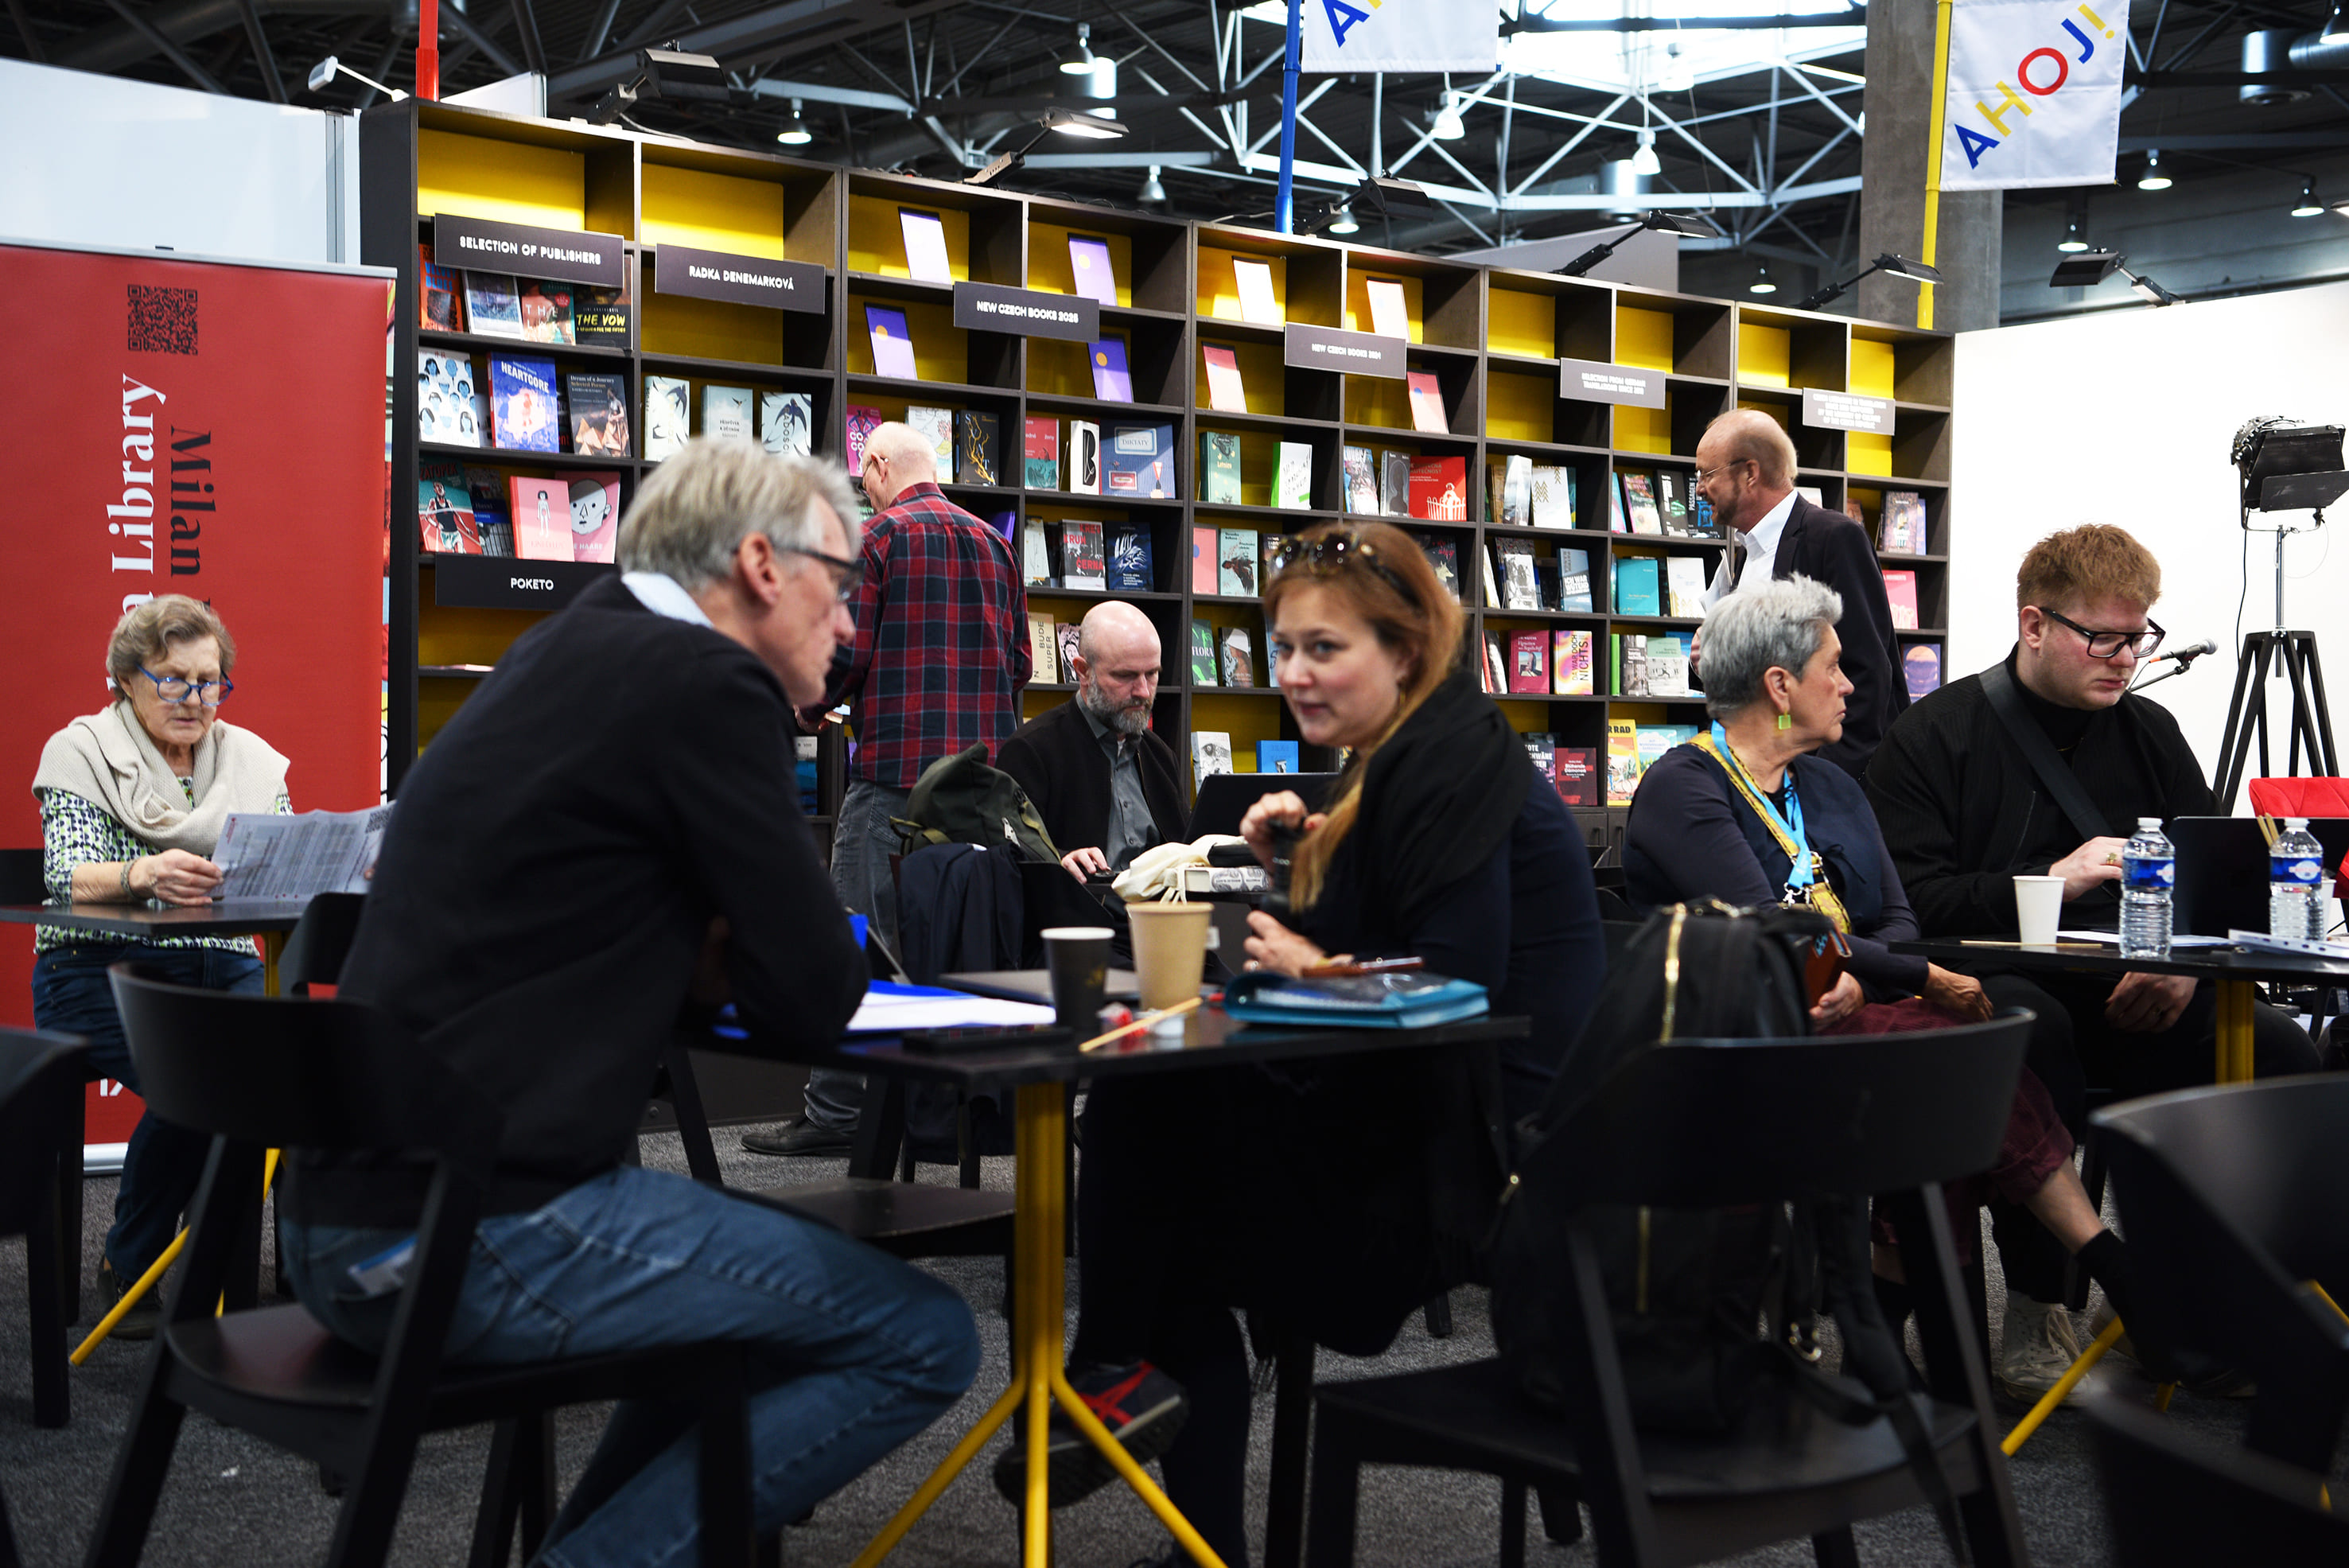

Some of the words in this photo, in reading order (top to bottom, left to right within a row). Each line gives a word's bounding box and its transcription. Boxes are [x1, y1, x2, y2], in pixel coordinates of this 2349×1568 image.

[1954, 3, 2115, 169] AHOJ!
[460, 236, 519, 255] SELECTION
[522, 243, 537, 256] OF
[541, 247, 601, 265] PUBLISHERS
[426, 276, 453, 292] BLUES
[689, 265, 721, 281] RADKA
[723, 270, 795, 290] DENEMARKOVÁ
[577, 314, 598, 326] THE
[602, 313, 626, 326] VOW
[977, 300, 998, 313] NEW
[998, 303, 1027, 317] CZECH
[1028, 307, 1058, 321] BOOKS
[1312, 343, 1326, 353] NEW
[501, 360, 550, 394] HEARTCORE
[107, 372, 166, 574] Library
[170, 425, 216, 578] Milan
[510, 578, 554, 590] POKETO
[1192, 645, 1214, 657] FLORA
[1578, 641, 1589, 681] NICHTS
